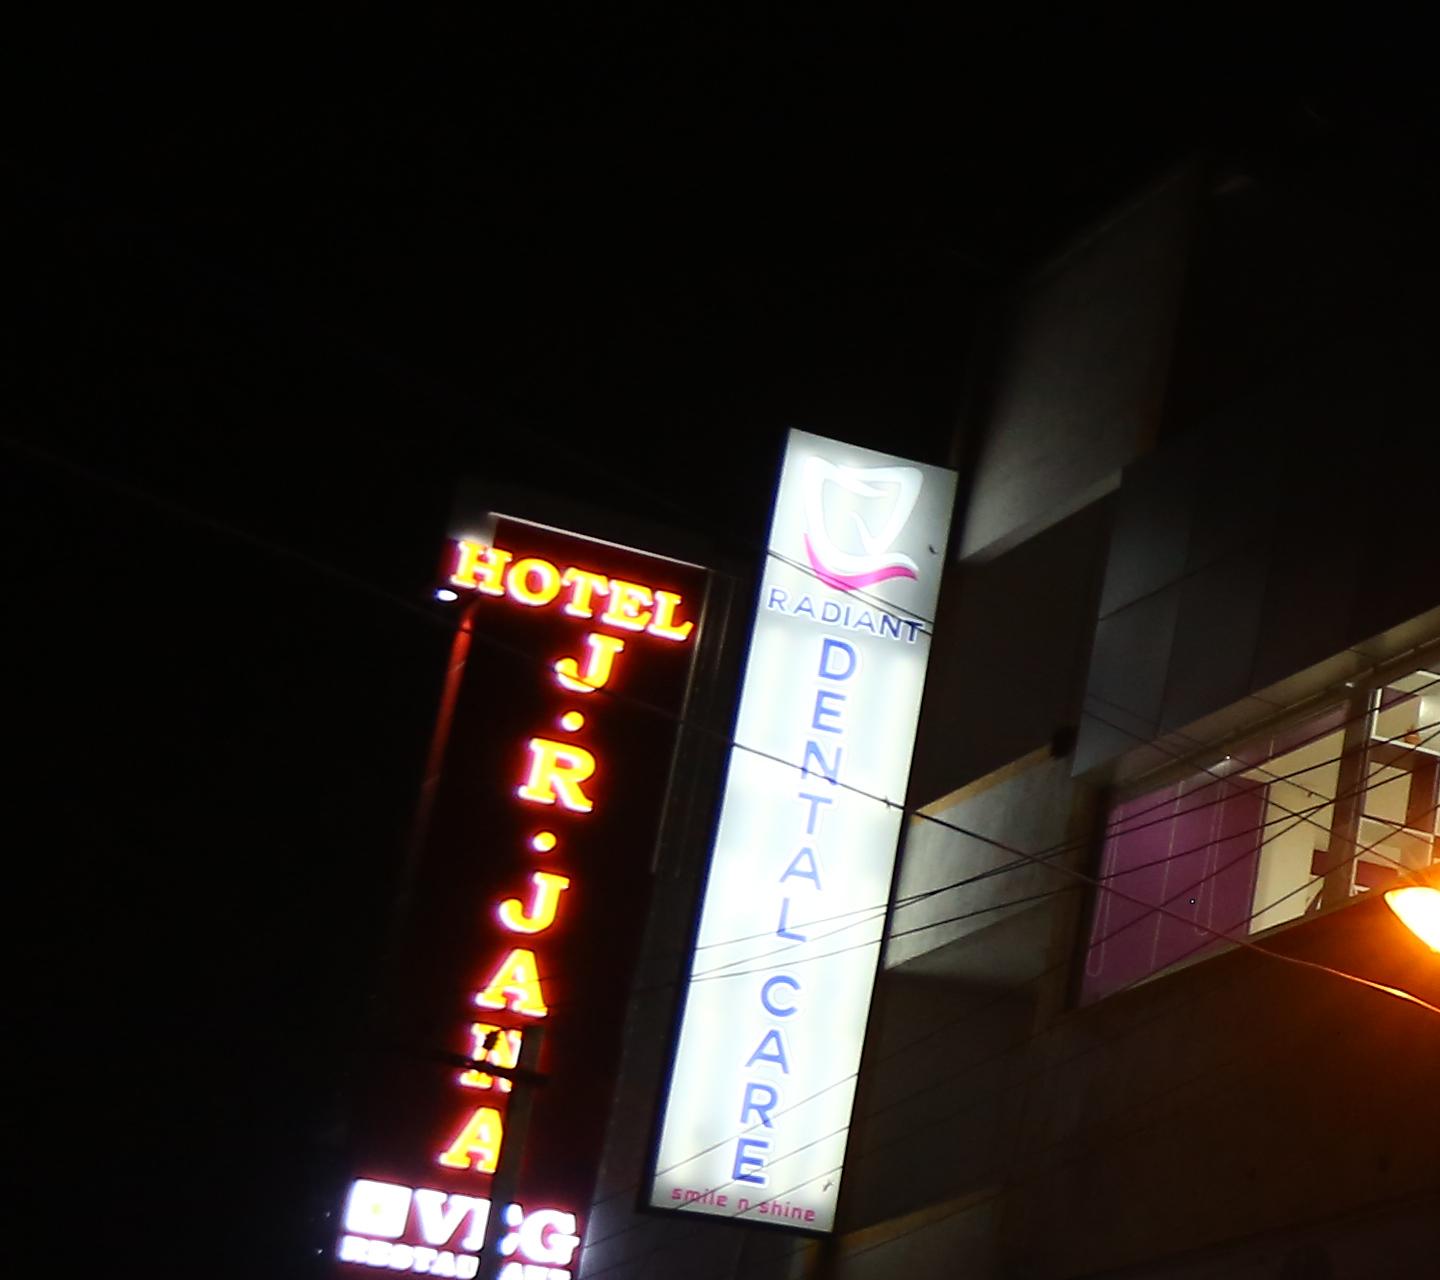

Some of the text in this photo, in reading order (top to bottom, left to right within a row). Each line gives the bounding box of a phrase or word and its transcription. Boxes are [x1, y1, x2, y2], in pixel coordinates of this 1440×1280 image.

[450, 539, 694, 641] HOTEL
[768, 587, 924, 644] RADIANT
[732, 638, 857, 1185] DENTAL CARE
[671, 1185, 727, 1208] smile
[759, 1199, 816, 1222] shine
